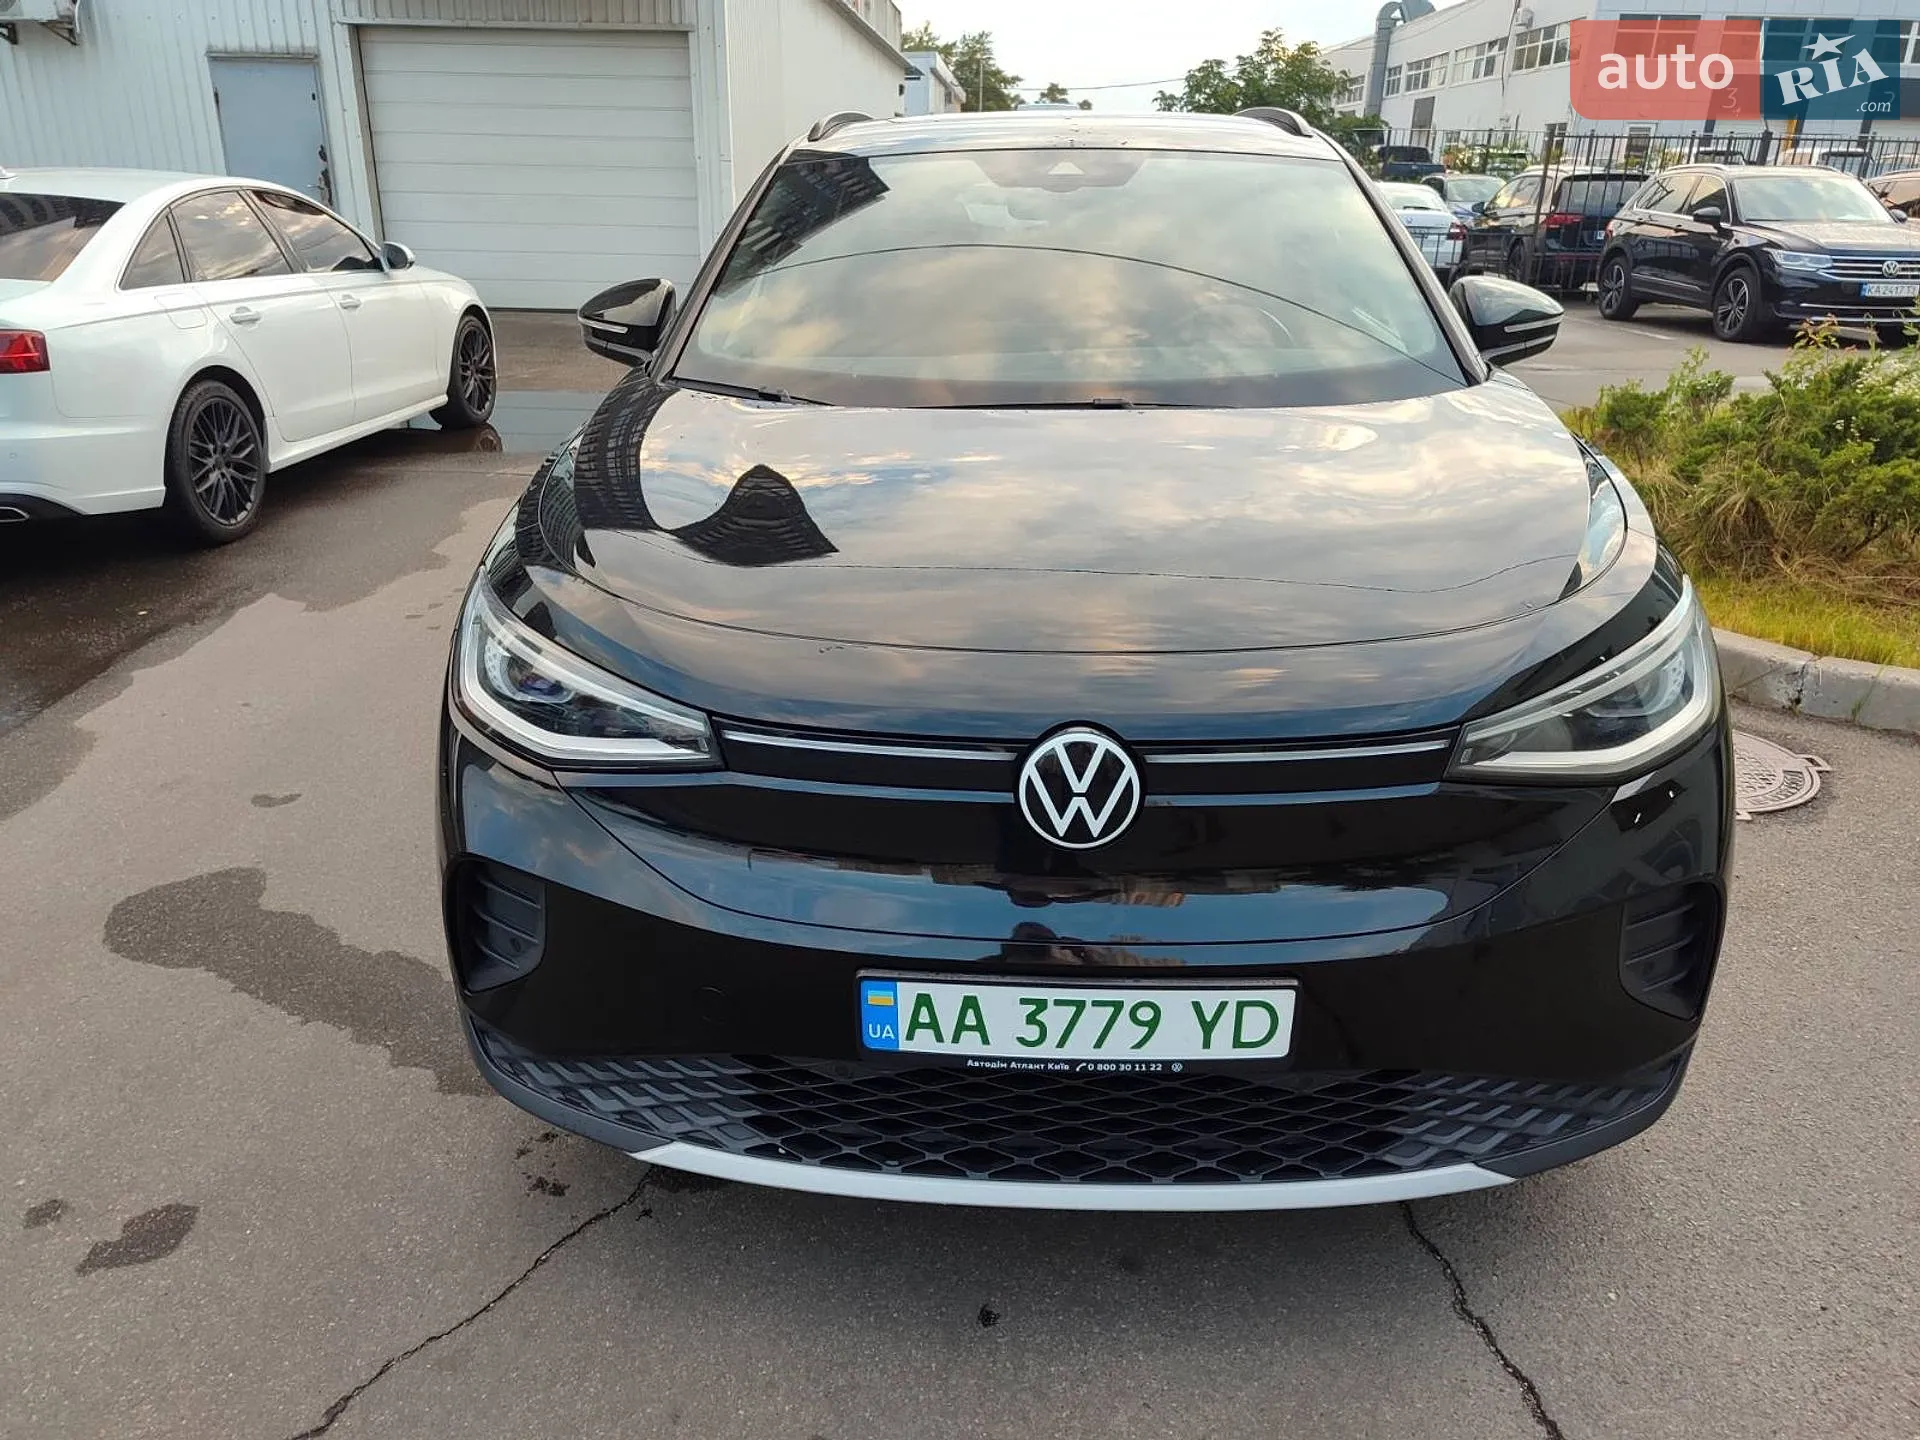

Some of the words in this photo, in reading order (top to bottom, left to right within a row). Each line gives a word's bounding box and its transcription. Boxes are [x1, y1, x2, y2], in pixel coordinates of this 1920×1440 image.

[905, 993, 991, 1046] AA
[1015, 997, 1162, 1051] 3779
[1190, 999, 1279, 1050] YD
[868, 1024, 895, 1040] UA
[1010, 1061, 1045, 1070] Атлант
